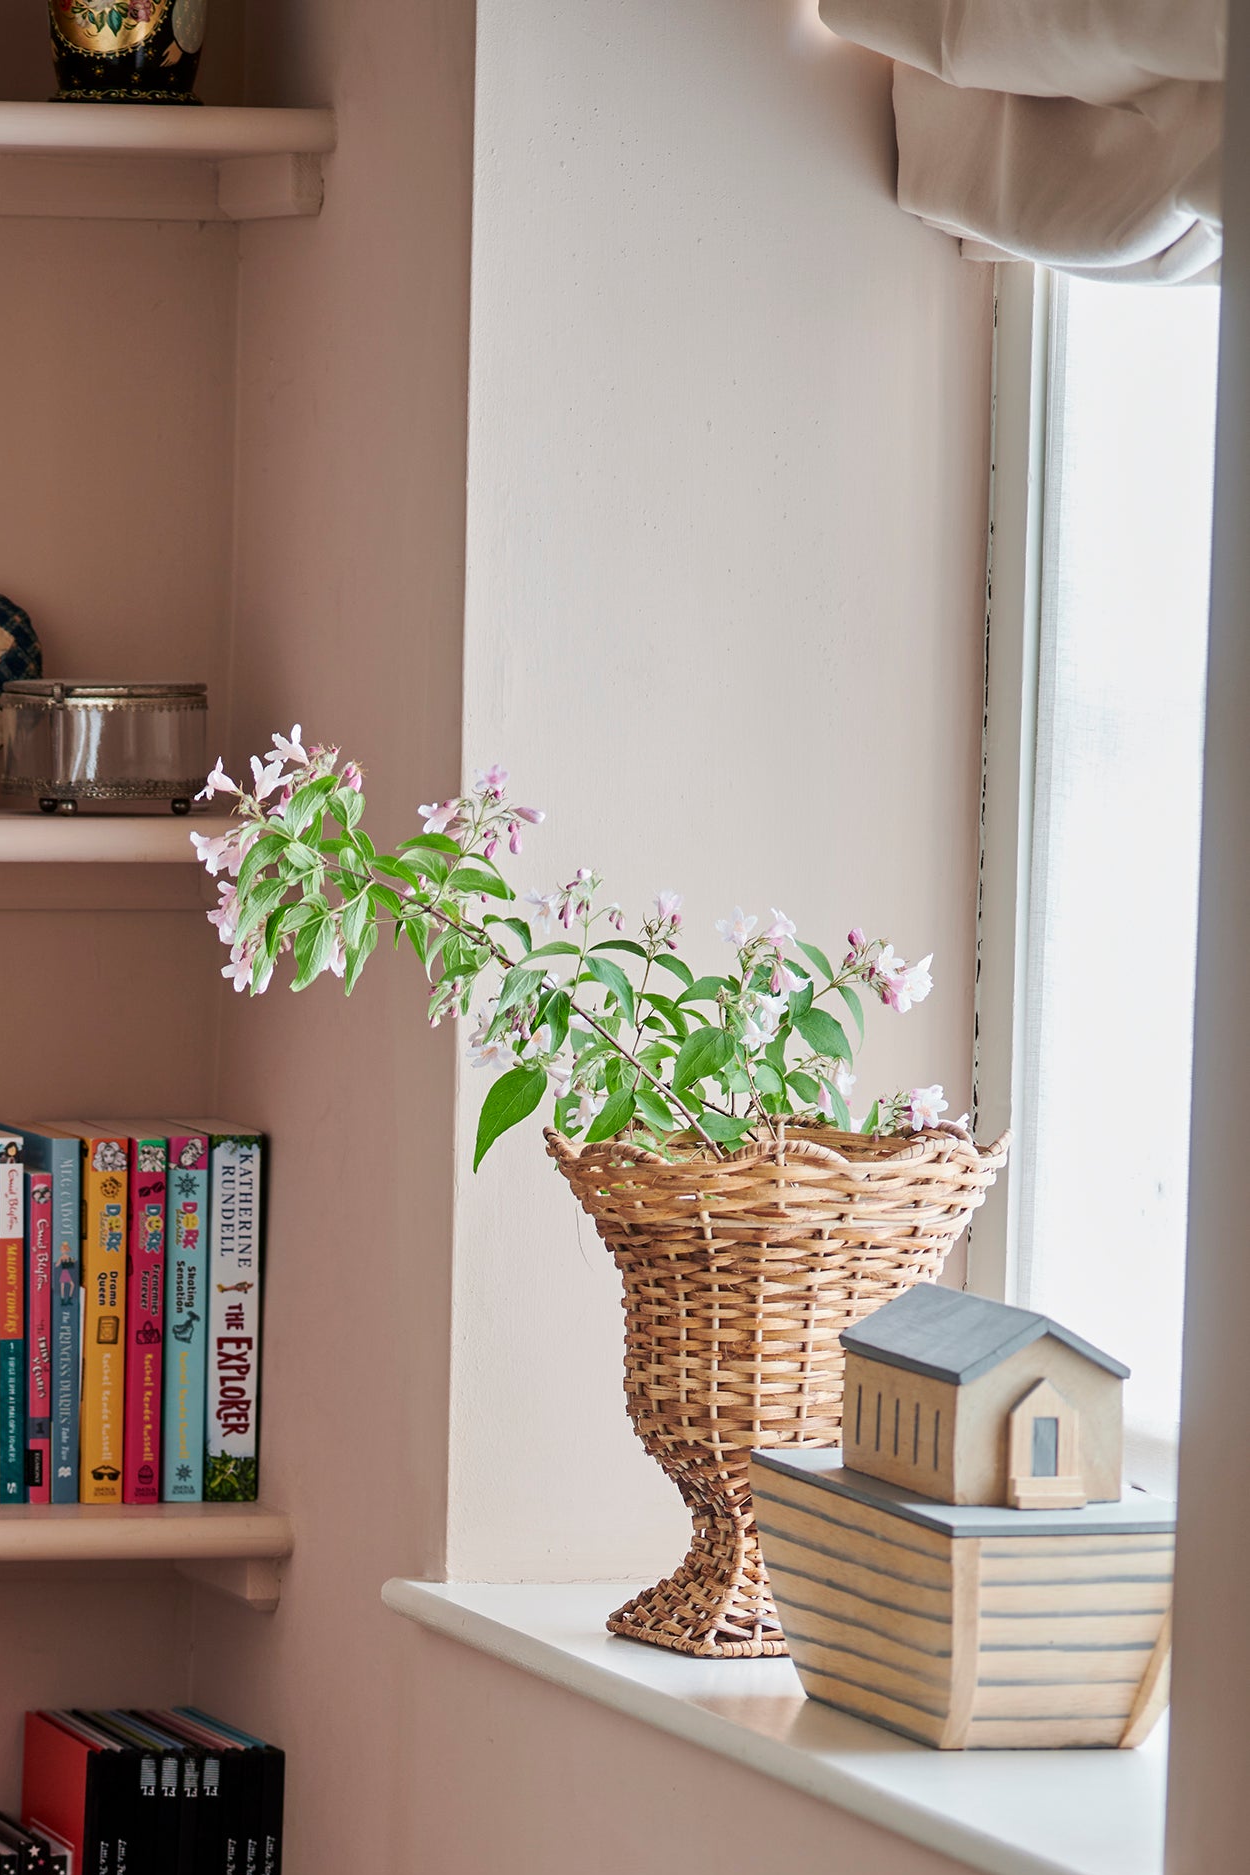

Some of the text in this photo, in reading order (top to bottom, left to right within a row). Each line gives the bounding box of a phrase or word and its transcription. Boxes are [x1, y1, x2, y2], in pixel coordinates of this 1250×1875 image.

[7, 1168, 19, 1231] Enid Blyton
[220, 1165, 236, 1257] RUNDELL
[237, 1153, 253, 1268] KATHERINE
[34, 1218, 49, 1292] Enid Blyton
[98, 1272, 108, 1306] Queen
[109, 1271, 118, 1307] Drama
[141, 1270, 150, 1309] Forever
[152, 1264, 161, 1316] Frenemies
[176, 1260, 186, 1314] Sensation
[187, 1266, 197, 1309] Skating
[215, 1303, 253, 1438] THE EXPLORER
